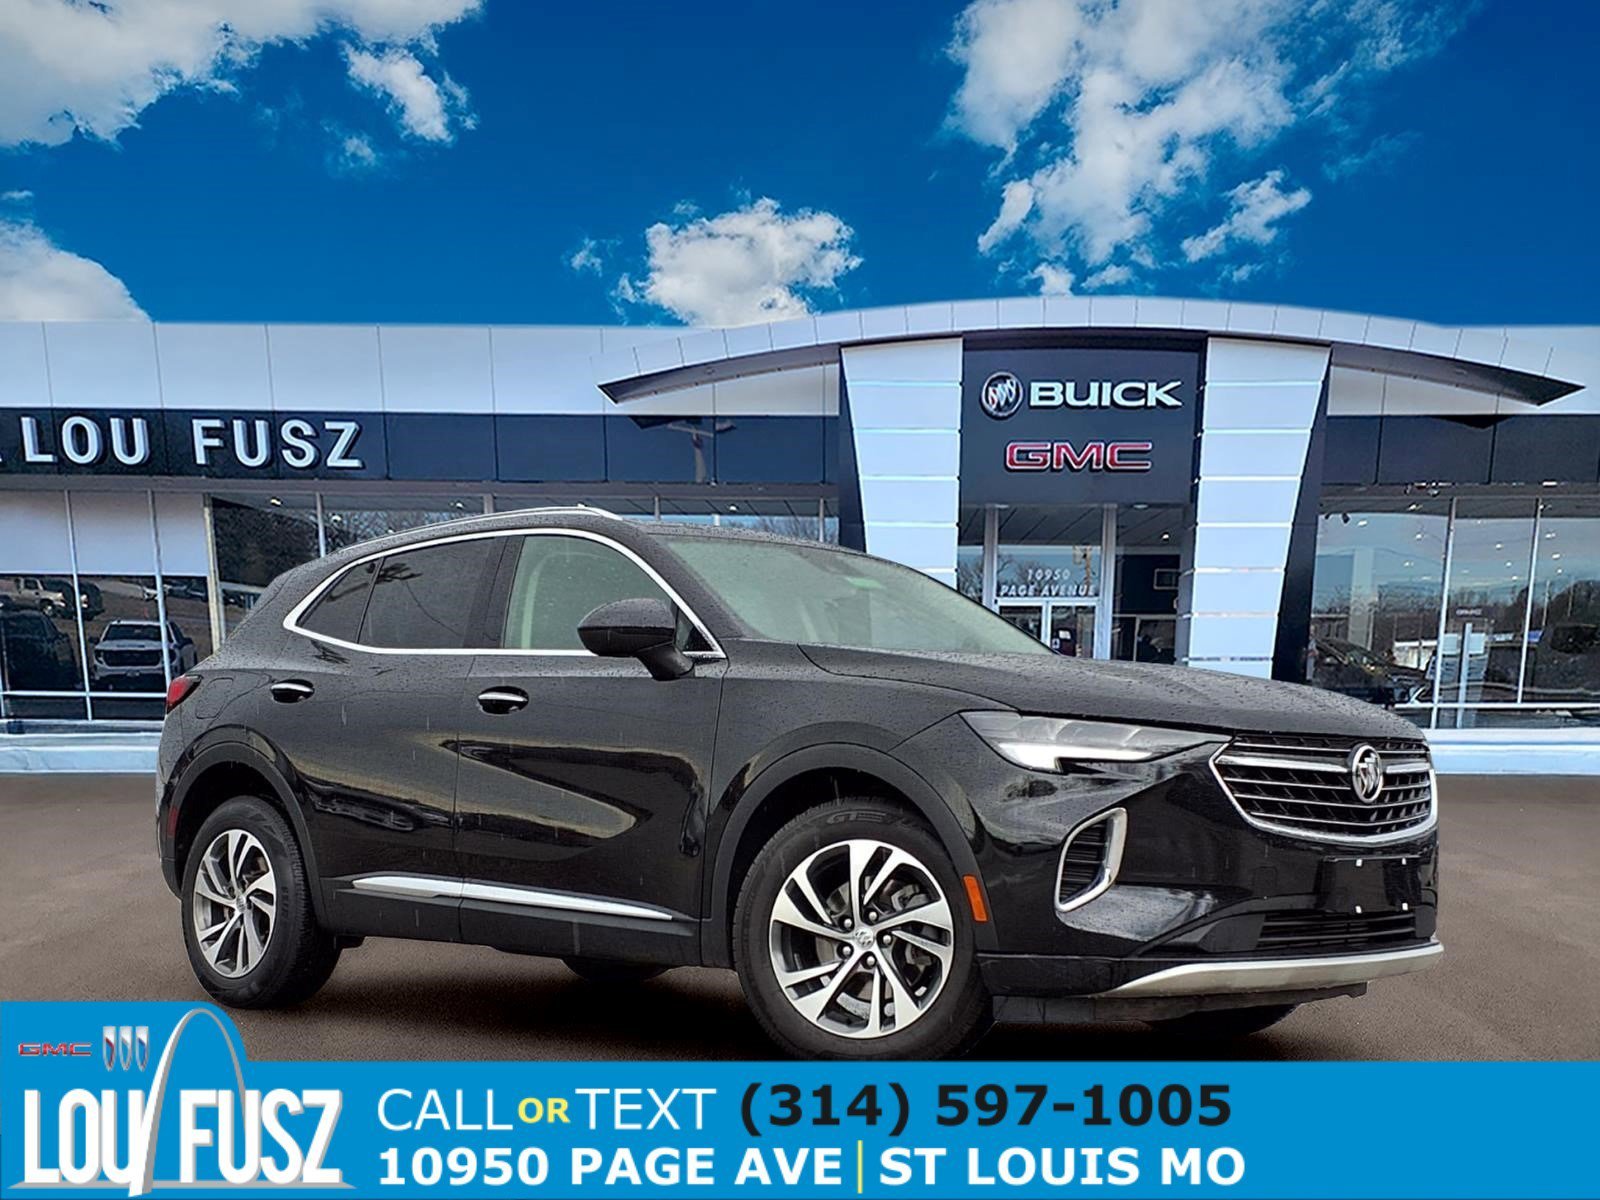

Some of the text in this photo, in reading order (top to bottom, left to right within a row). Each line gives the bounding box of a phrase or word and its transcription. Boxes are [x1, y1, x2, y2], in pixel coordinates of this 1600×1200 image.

[1029, 381, 1183, 408] BUICK
[19, 416, 363, 469] LOU FUSZ
[1006, 441, 1153, 471] GMC
[1027, 569, 1071, 581] 10950
[1000, 584, 1097, 597] PAGE AVENUE
